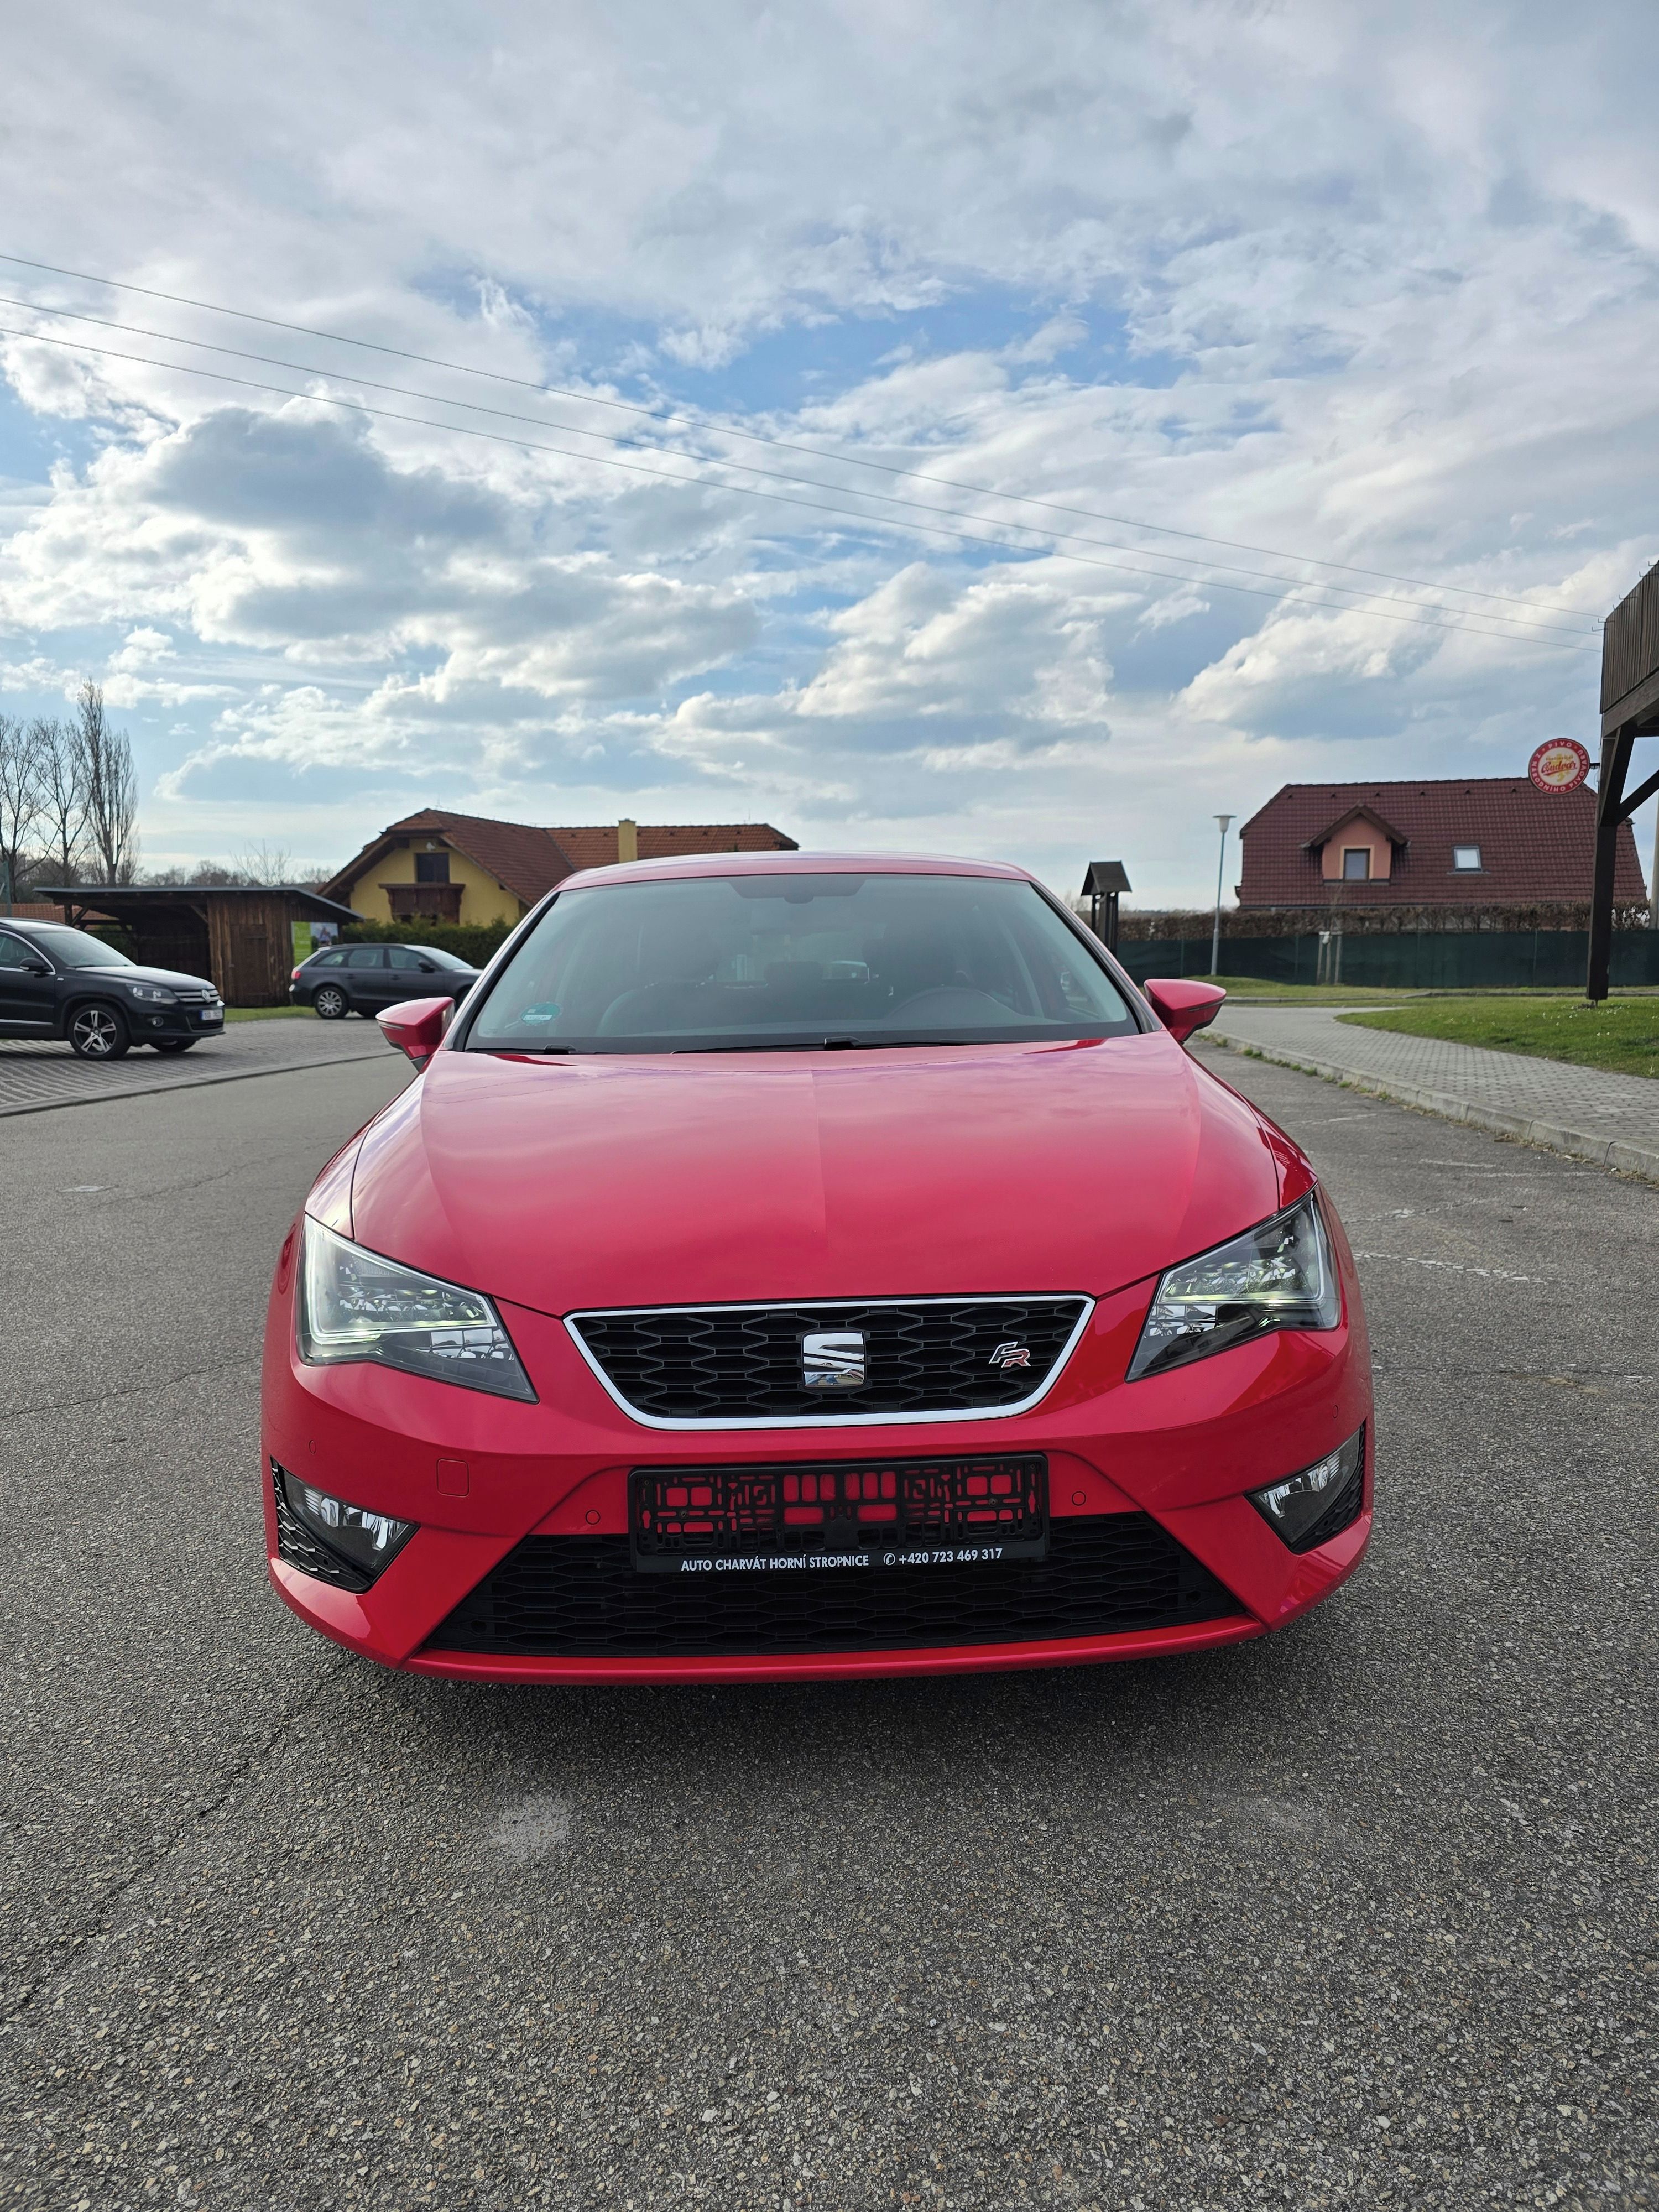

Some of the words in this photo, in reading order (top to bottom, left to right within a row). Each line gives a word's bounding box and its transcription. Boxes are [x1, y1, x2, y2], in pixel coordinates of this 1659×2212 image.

[1541, 760, 1578, 775] Budvar
[1569, 749, 1587, 788] PIVOVARU
[989, 1341, 1031, 1368] FR
[681, 1559, 712, 1571] AUTO
[715, 1556, 767, 1571] CHARVÁT
[770, 1554, 806, 1569] HORNÍ
[809, 1554, 869, 1568] STROPNICE
[899, 1552, 929, 1564] +420
[932, 1551, 953, 1563] 723
[957, 1549, 978, 1561] 469
[982, 1547, 1003, 1560] 317
